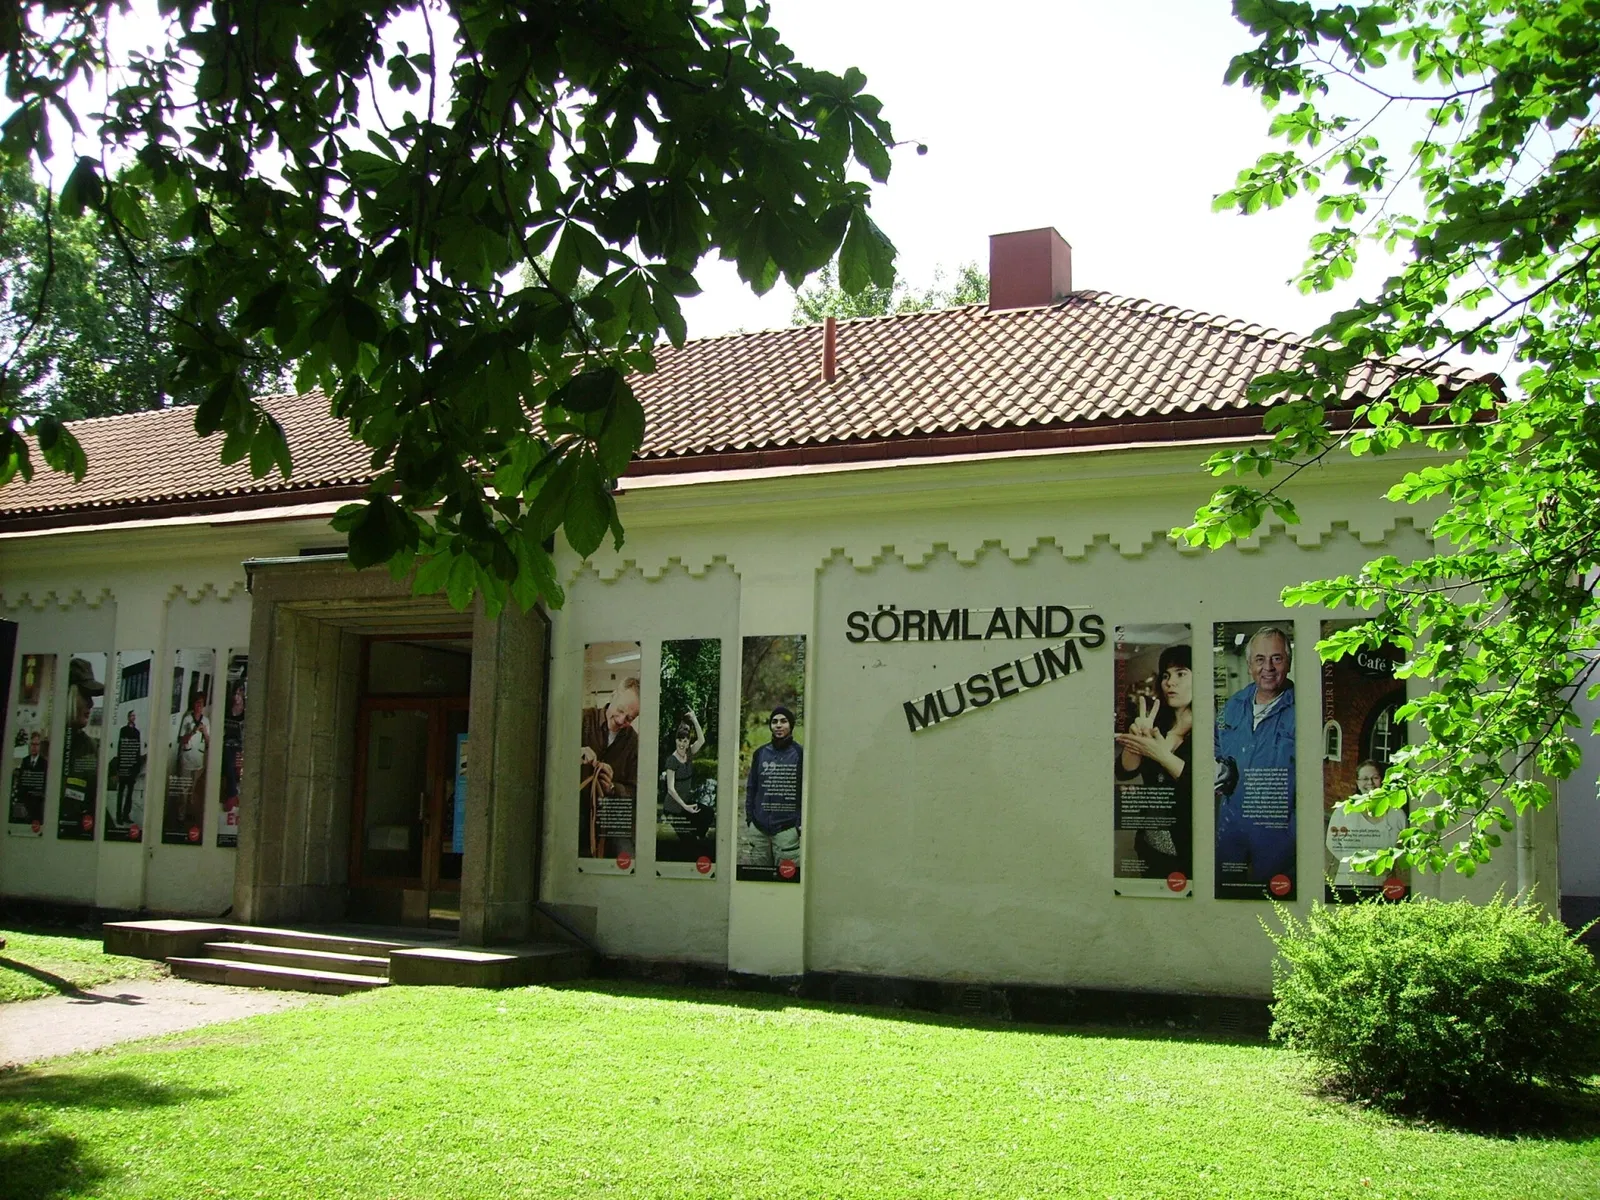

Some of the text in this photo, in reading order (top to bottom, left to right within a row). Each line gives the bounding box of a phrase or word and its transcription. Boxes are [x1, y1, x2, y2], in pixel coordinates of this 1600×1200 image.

[846, 604, 1106, 648] SÖRMLANDS
[1216, 623, 1226, 678] NYÖPING
[903, 639, 1083, 732] MUSEUM
[1357, 652, 1386, 671] Café
